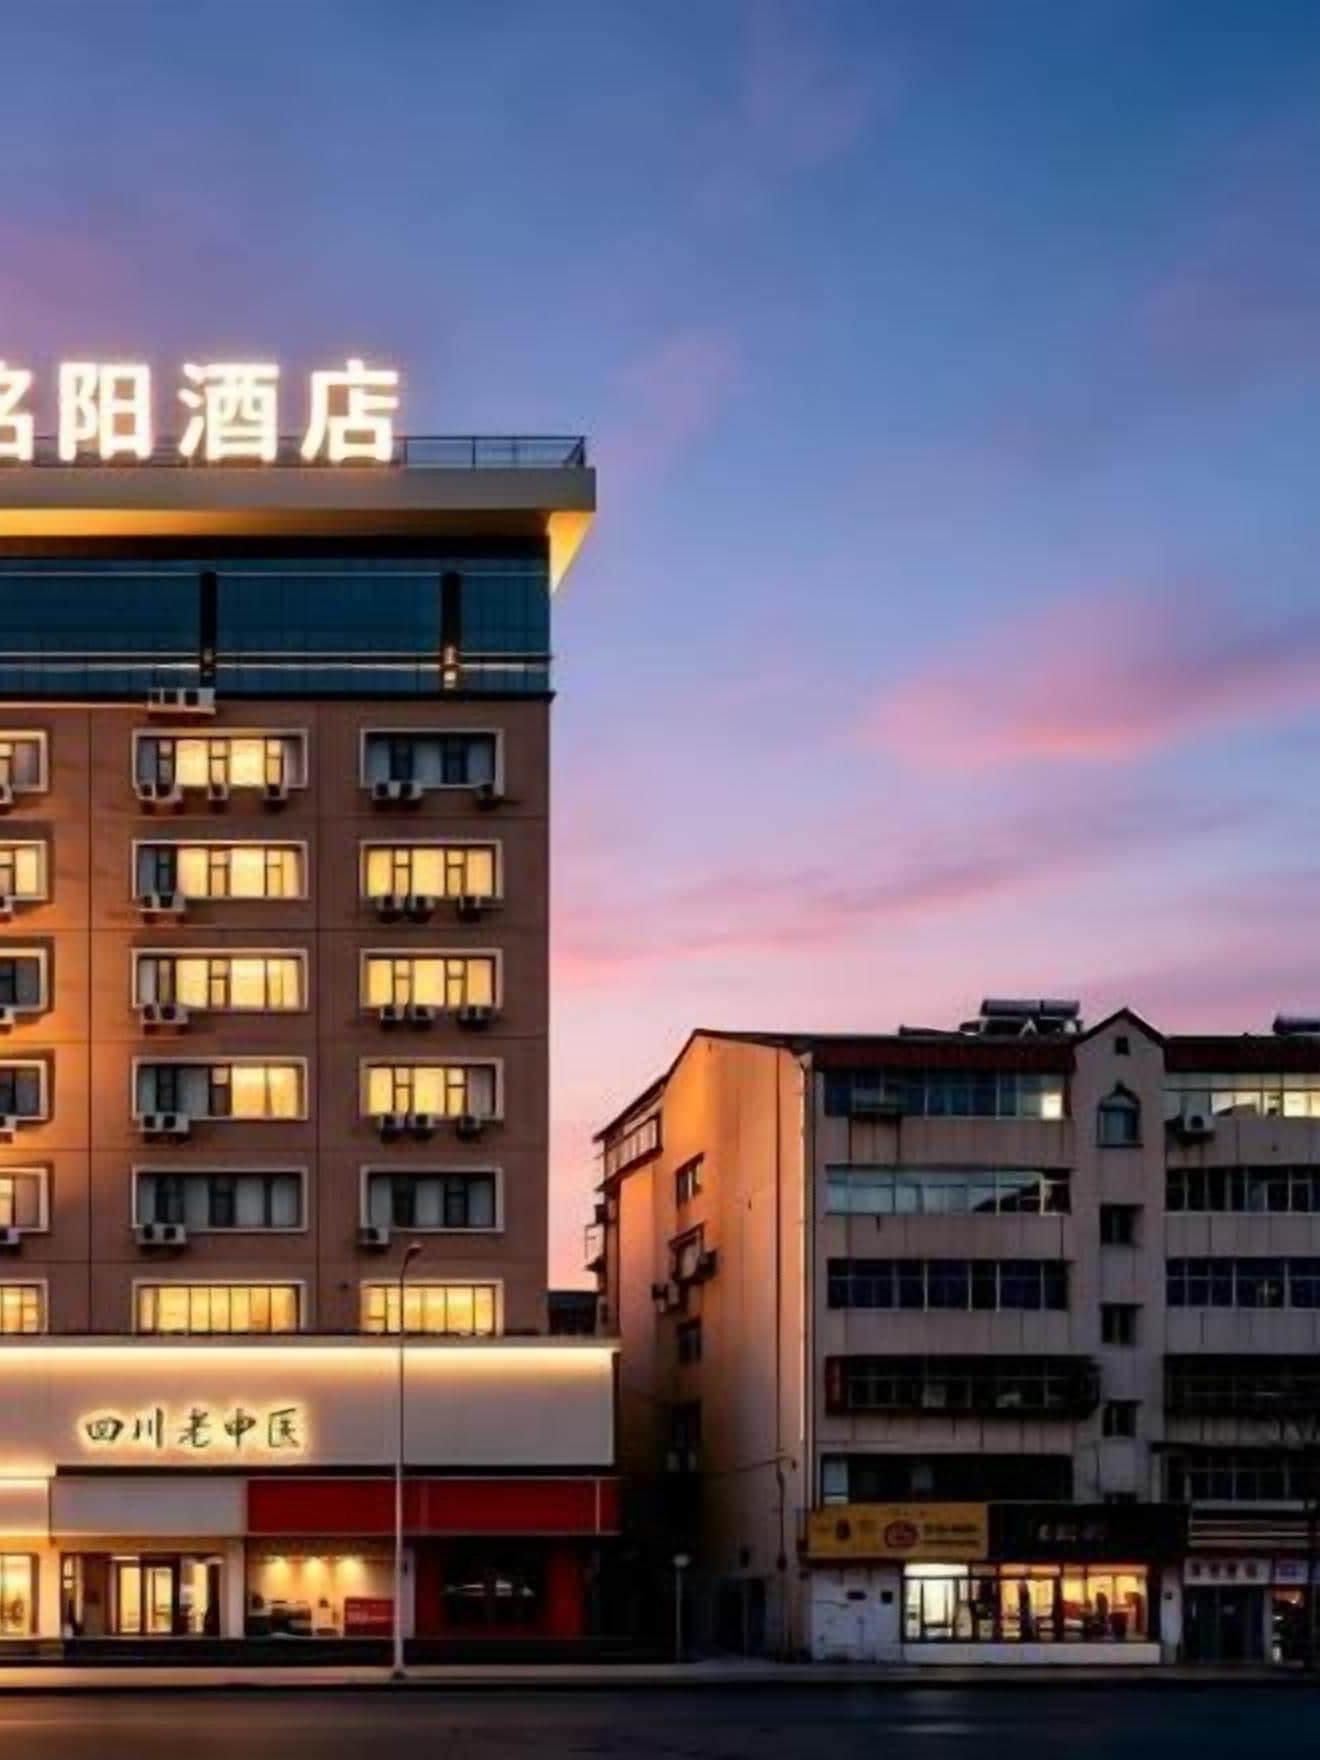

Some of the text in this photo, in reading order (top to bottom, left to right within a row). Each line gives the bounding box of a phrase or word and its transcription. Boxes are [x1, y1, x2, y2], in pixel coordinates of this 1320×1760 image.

[83, 1406, 304, 1449] 四川老中医
